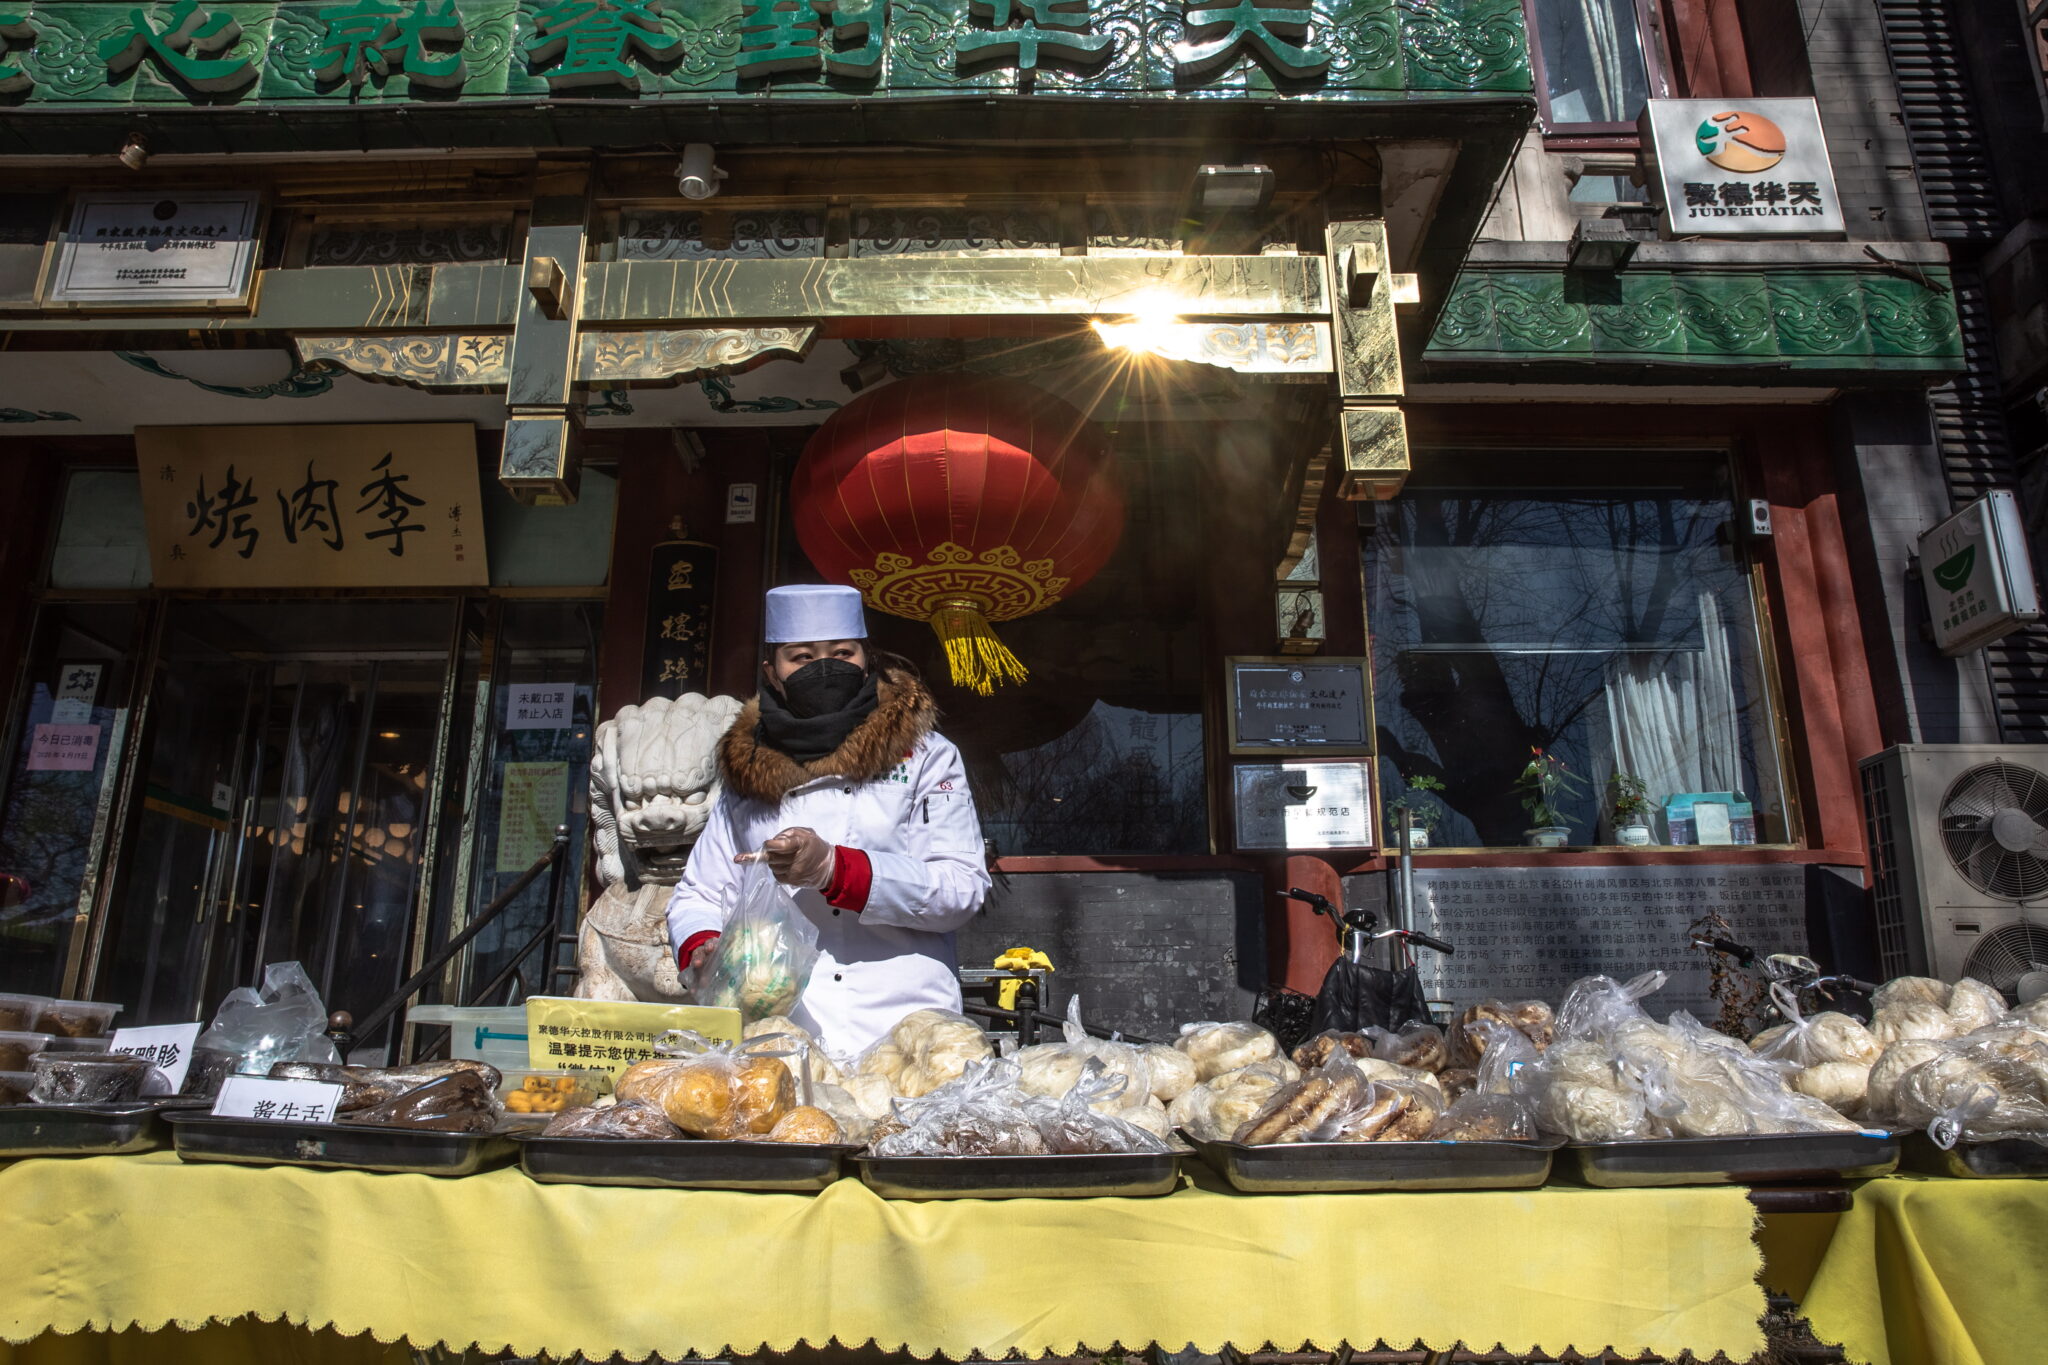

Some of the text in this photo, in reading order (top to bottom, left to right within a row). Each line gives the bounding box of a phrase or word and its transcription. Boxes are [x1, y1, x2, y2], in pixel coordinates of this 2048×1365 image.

[1684, 181, 1822, 206] 聚德华天
[1688, 207, 1824, 218] JUDEHUATIAN
[185, 452, 426, 559] 烤肉季
[1949, 590, 1975, 612] 北京市
[518, 692, 565, 704] 未戴口罩
[517, 708, 563, 720] 禁止入店
[38, 733, 93, 746] 今日已消毒
[940, 781, 953, 791] 63
[253, 1100, 325, 1122] 酱牛舌
